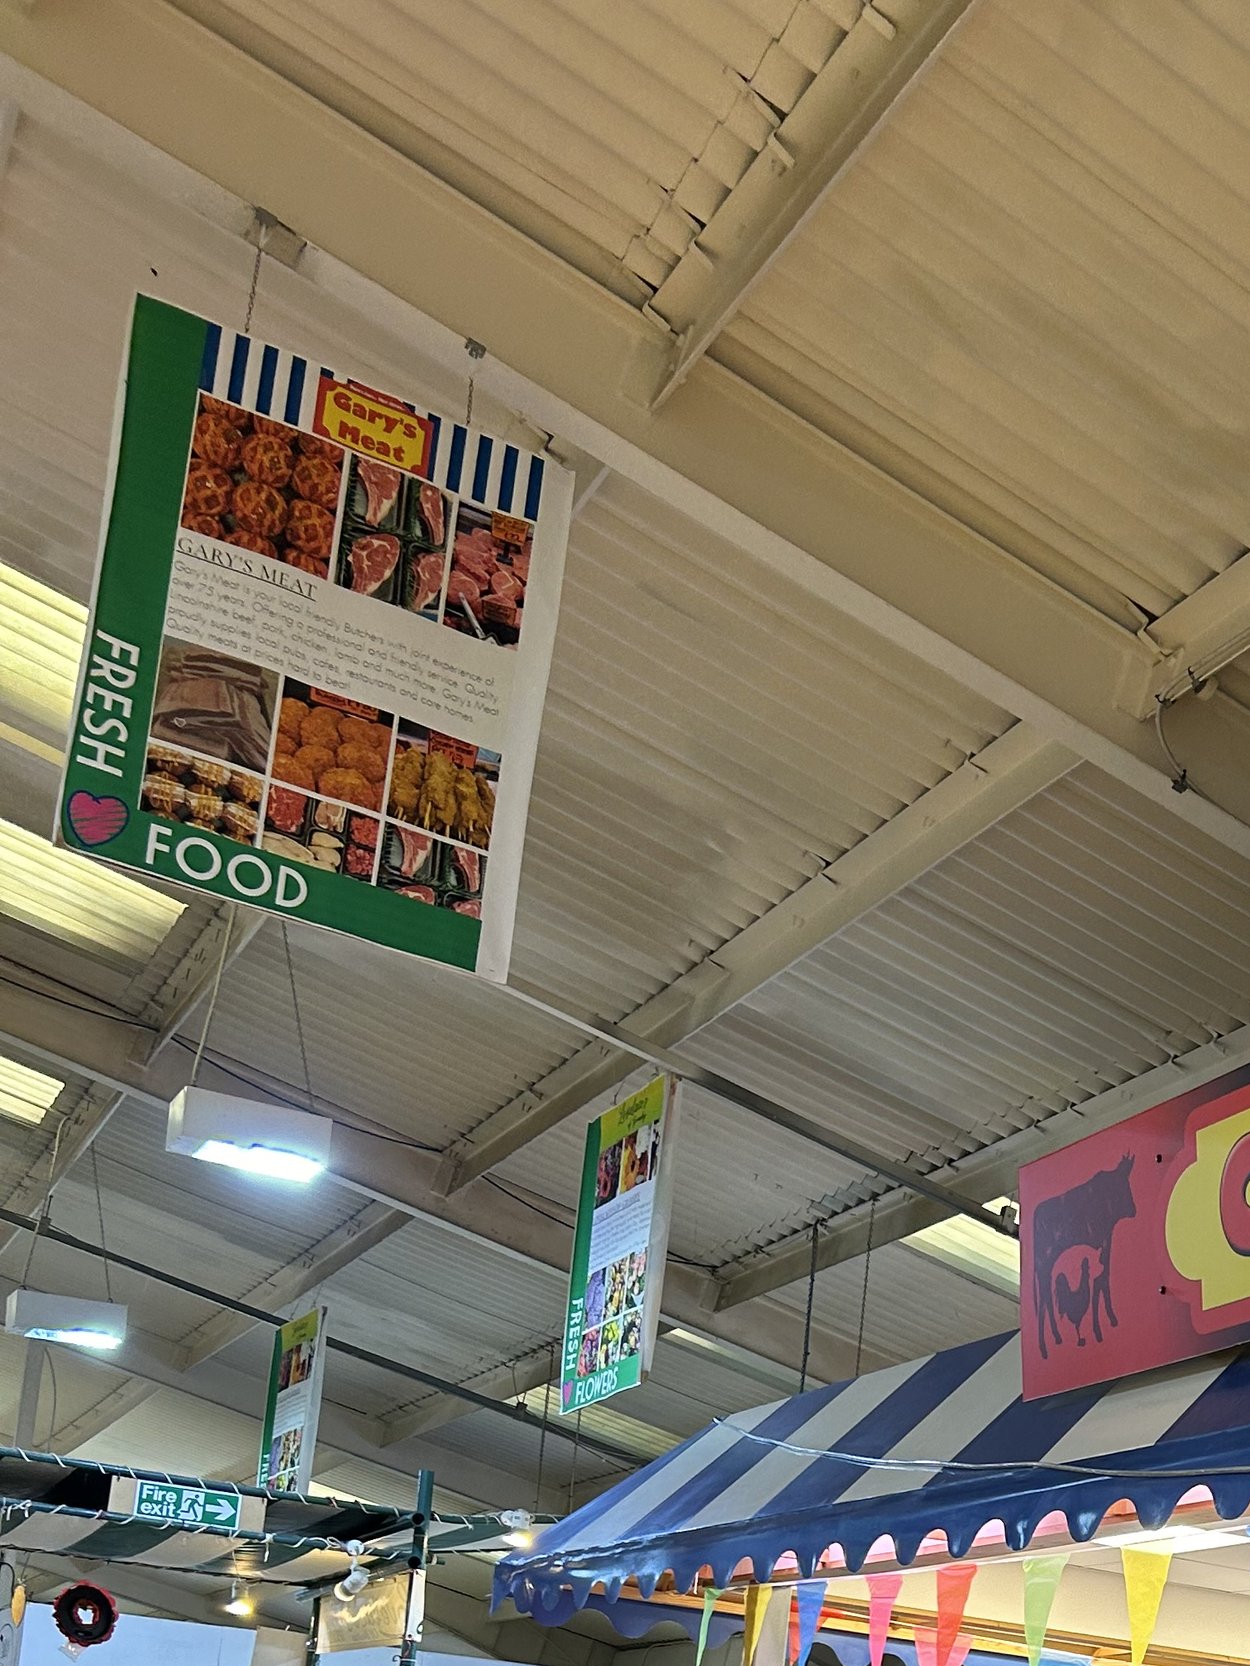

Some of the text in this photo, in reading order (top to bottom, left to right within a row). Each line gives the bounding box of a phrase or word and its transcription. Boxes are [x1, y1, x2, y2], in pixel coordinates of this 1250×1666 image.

[333, 392, 417, 439] Gary's
[338, 420, 405, 463] Meat
[178, 537, 318, 598] GARY'S MEAT
[75, 629, 140, 778] FRESH
[145, 822, 308, 908] FOOD
[565, 1297, 584, 1371] FRESH
[574, 1366, 619, 1403] FLOWERS
[140, 1501, 177, 1517] exit
[141, 1484, 178, 1503] Fire
